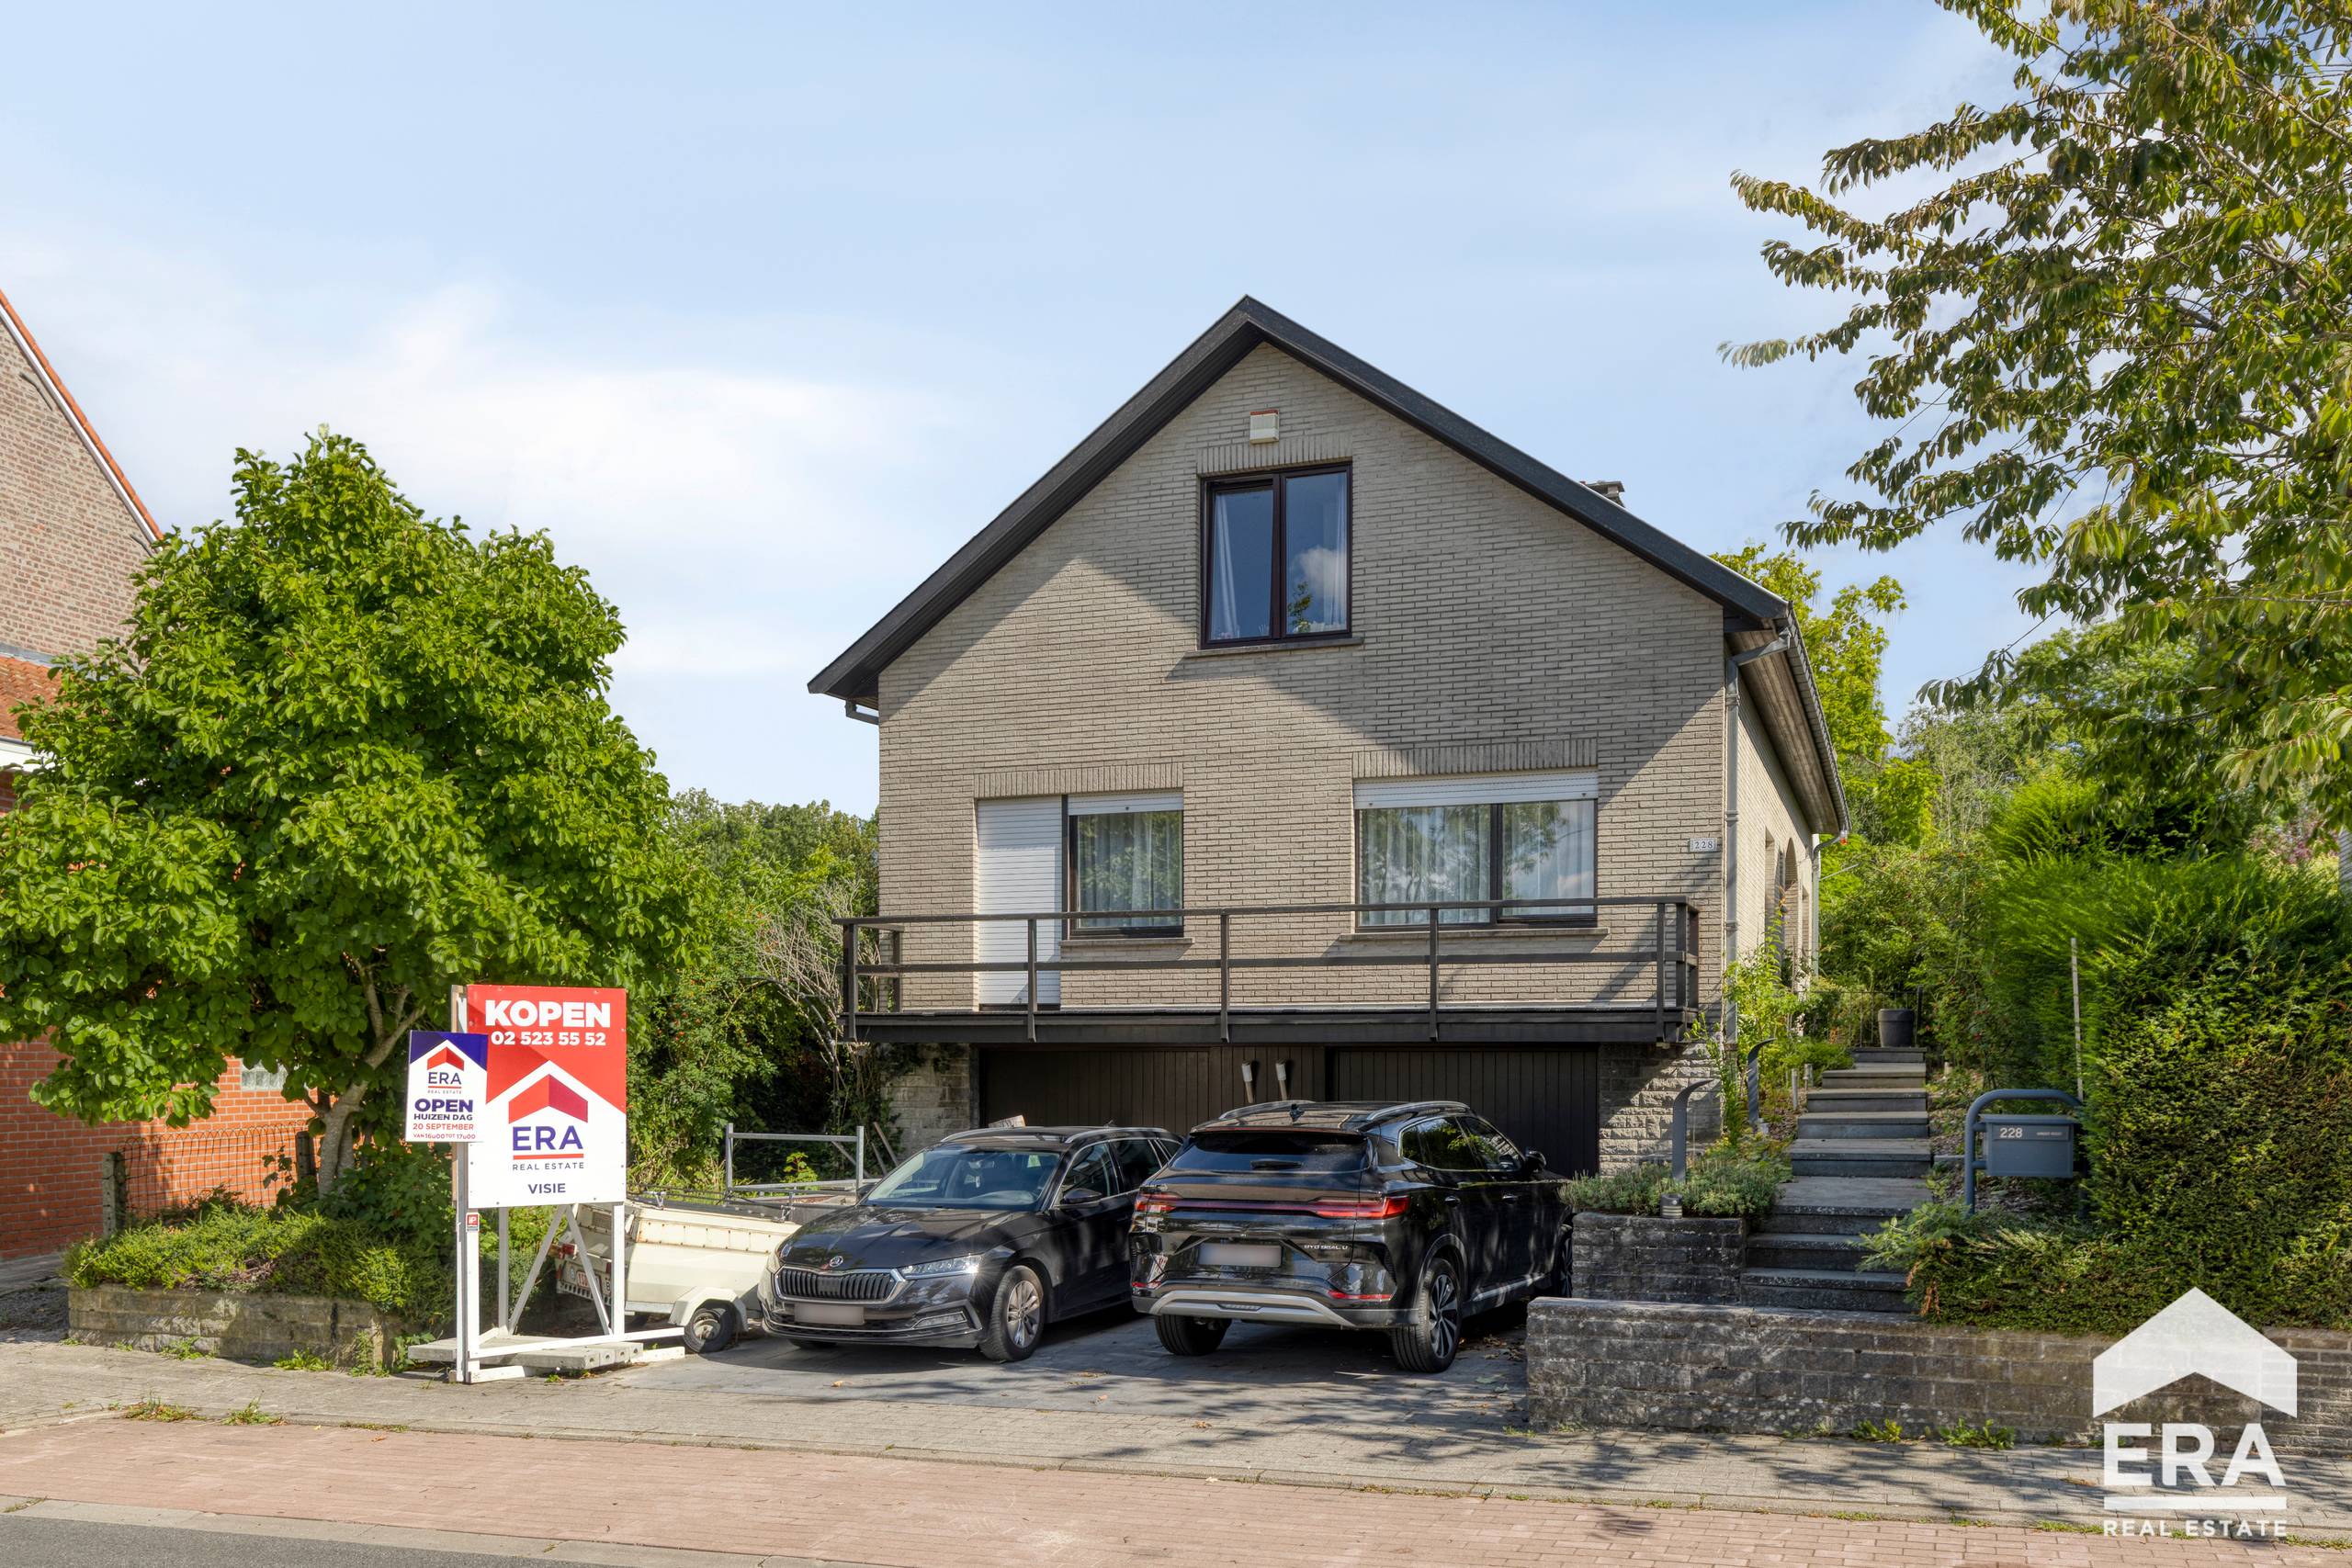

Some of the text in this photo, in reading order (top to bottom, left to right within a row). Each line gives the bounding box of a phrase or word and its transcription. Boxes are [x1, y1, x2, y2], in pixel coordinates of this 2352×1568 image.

[1695, 840, 1713, 849] 228
[485, 999, 611, 1028] KOPEN
[491, 1031, 606, 1046] 02 523 55 52
[428, 1072, 462, 1085] ERA
[414, 1098, 473, 1112] OPEN
[425, 1122, 474, 1131] SEPTEMBER
[1999, 1127, 2023, 1138] 228
[513, 1125, 583, 1151] ERA
[513, 1162, 584, 1171] REAL ESTATE
[527, 1183, 566, 1194] VISIE
